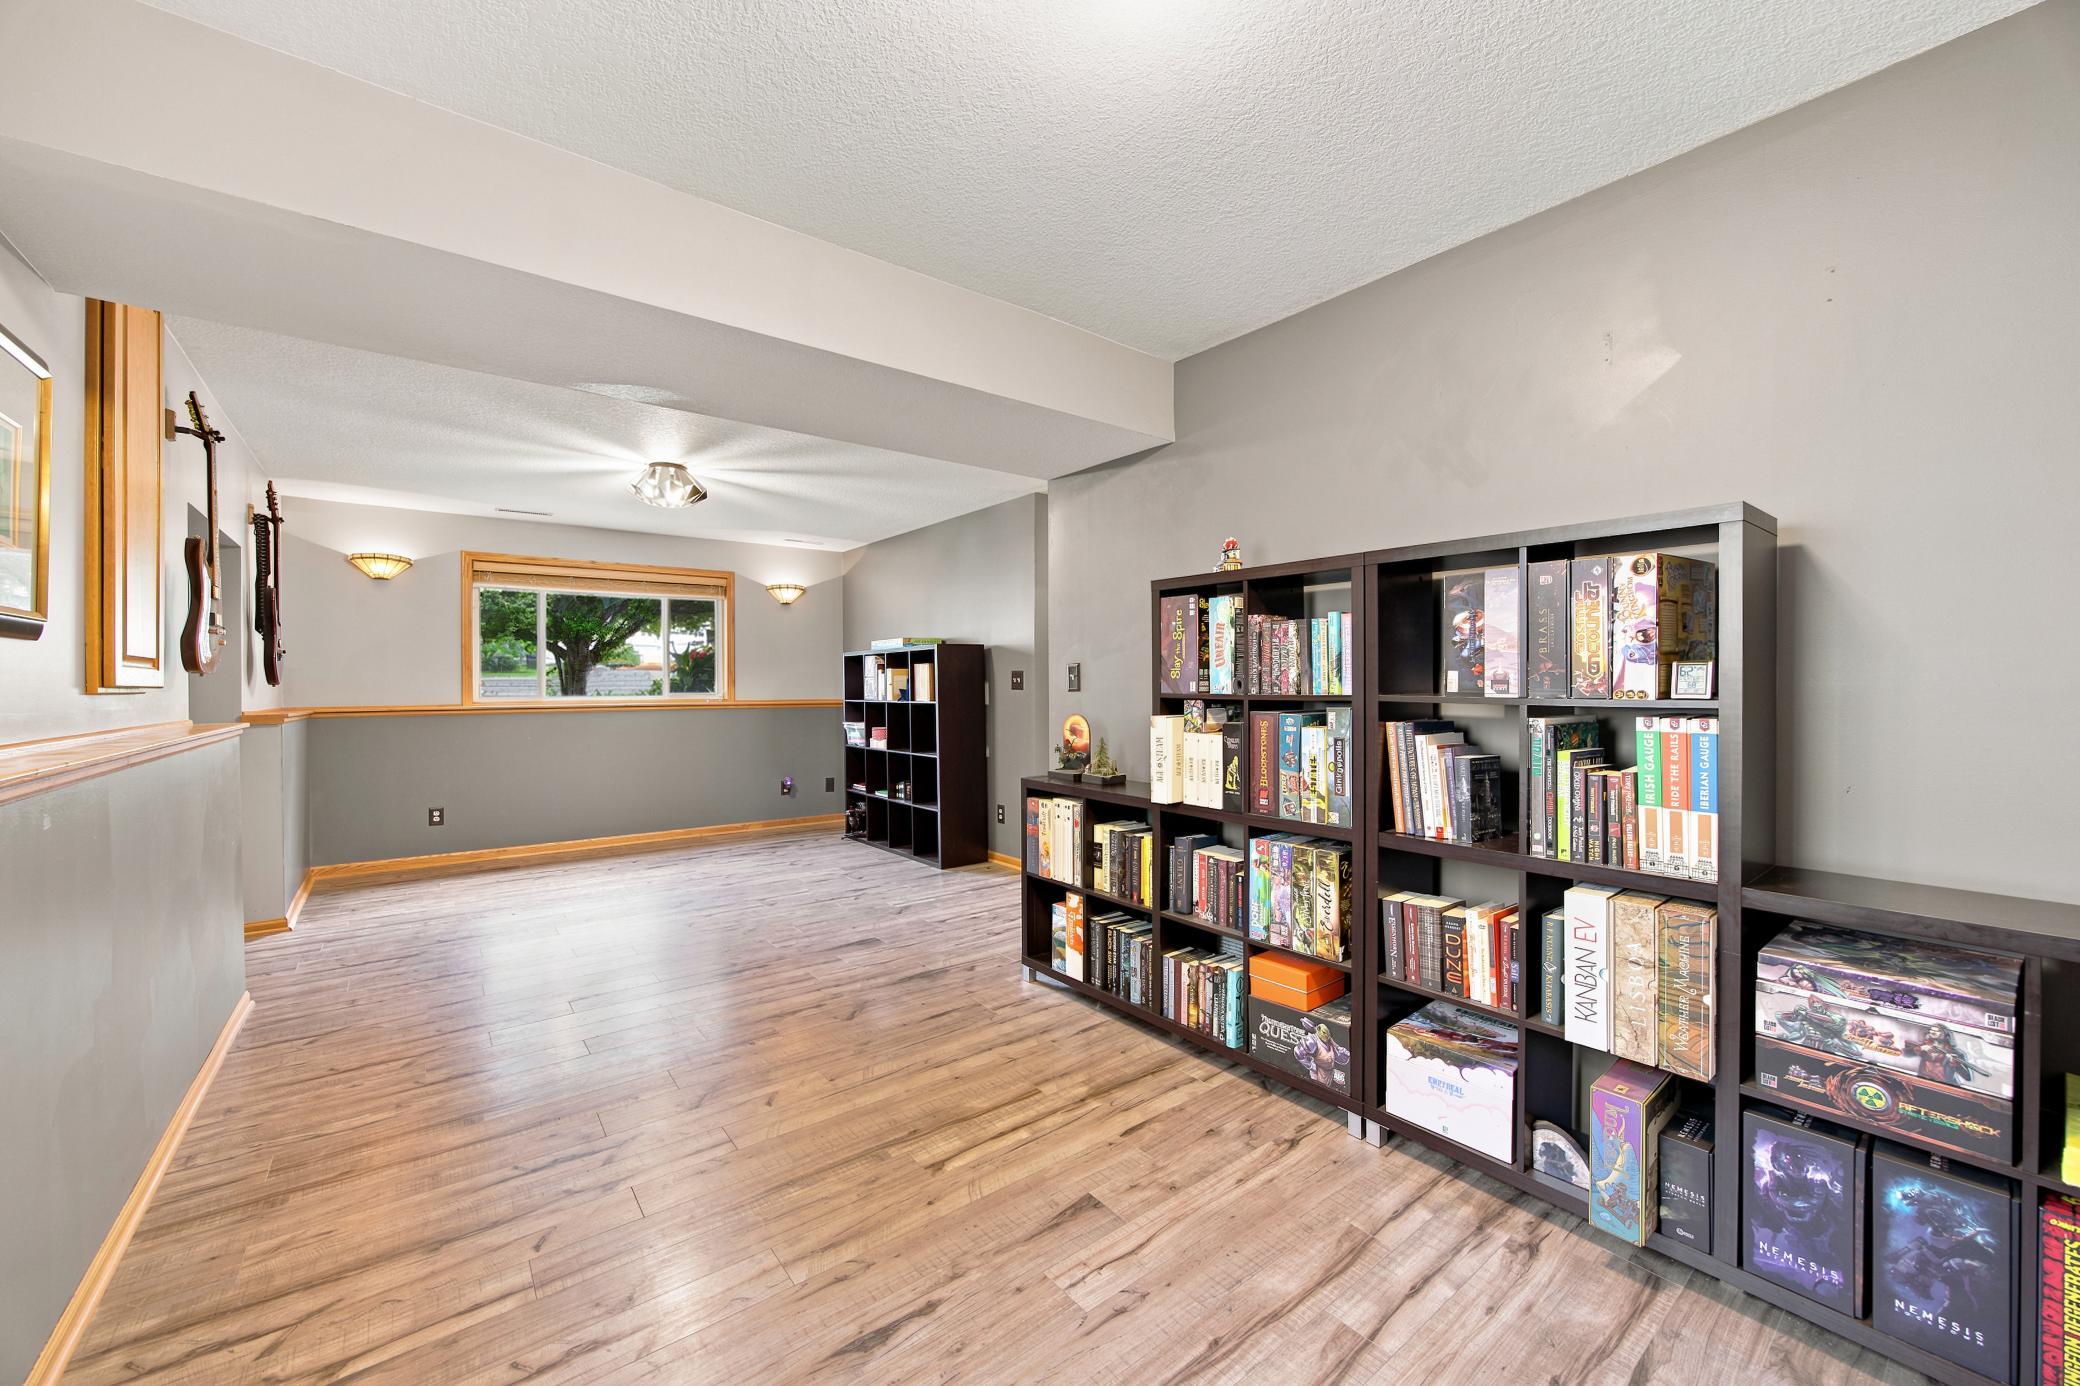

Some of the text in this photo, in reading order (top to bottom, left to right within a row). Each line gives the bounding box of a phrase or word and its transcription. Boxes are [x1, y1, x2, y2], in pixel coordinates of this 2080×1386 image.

[1172, 609, 1185, 640] Spire
[1538, 608, 1548, 654] BRASS
[1170, 655, 1184, 679] Slay
[1259, 720, 1269, 788] BLOODSTONES
[1335, 740, 1344, 794] Ginkgopolis
[1643, 732, 1655, 804] IRISH GAUGE
[1670, 733, 1680, 807] RIDE THE RAILS
[1699, 735, 1710, 809] IBERIAN GAUGE
[1317, 878, 1334, 932] Everdell
[1511, 961, 1519, 980] Salt
[1574, 916, 1598, 1024] KANBAN EV
[1627, 942, 1647, 1027] LISBOA
[1545, 974, 1553, 1014] KATABASIS
[1898, 1102, 2001, 1138] AFTERSHOCK
[1664, 1181, 1705, 1201] NEMESIS
[1759, 1241, 1840, 1281] NEMESIS
[1894, 1298, 1985, 1342] NEMESIS
